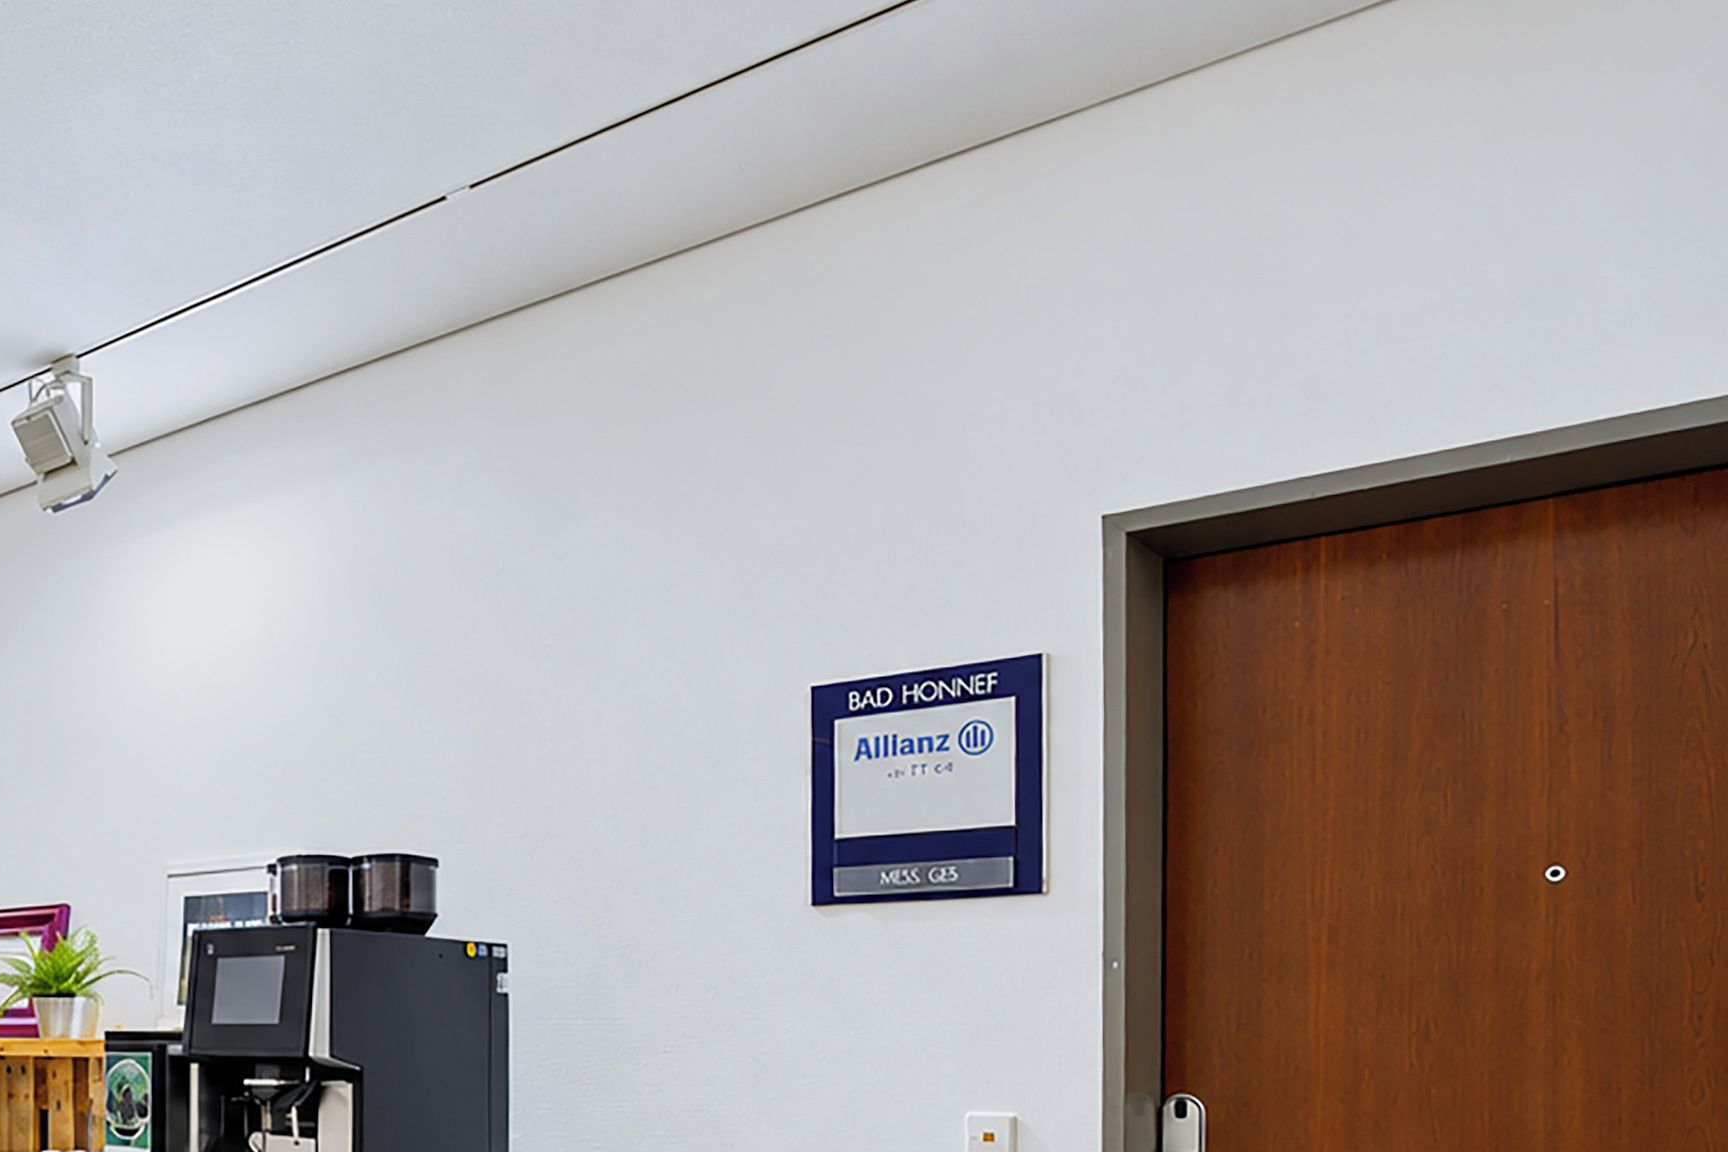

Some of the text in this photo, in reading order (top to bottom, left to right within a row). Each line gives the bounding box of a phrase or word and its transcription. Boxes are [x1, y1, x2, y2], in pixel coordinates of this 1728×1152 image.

[848, 672, 998, 711] BAD HONNEF
[854, 733, 950, 761] Allianz
